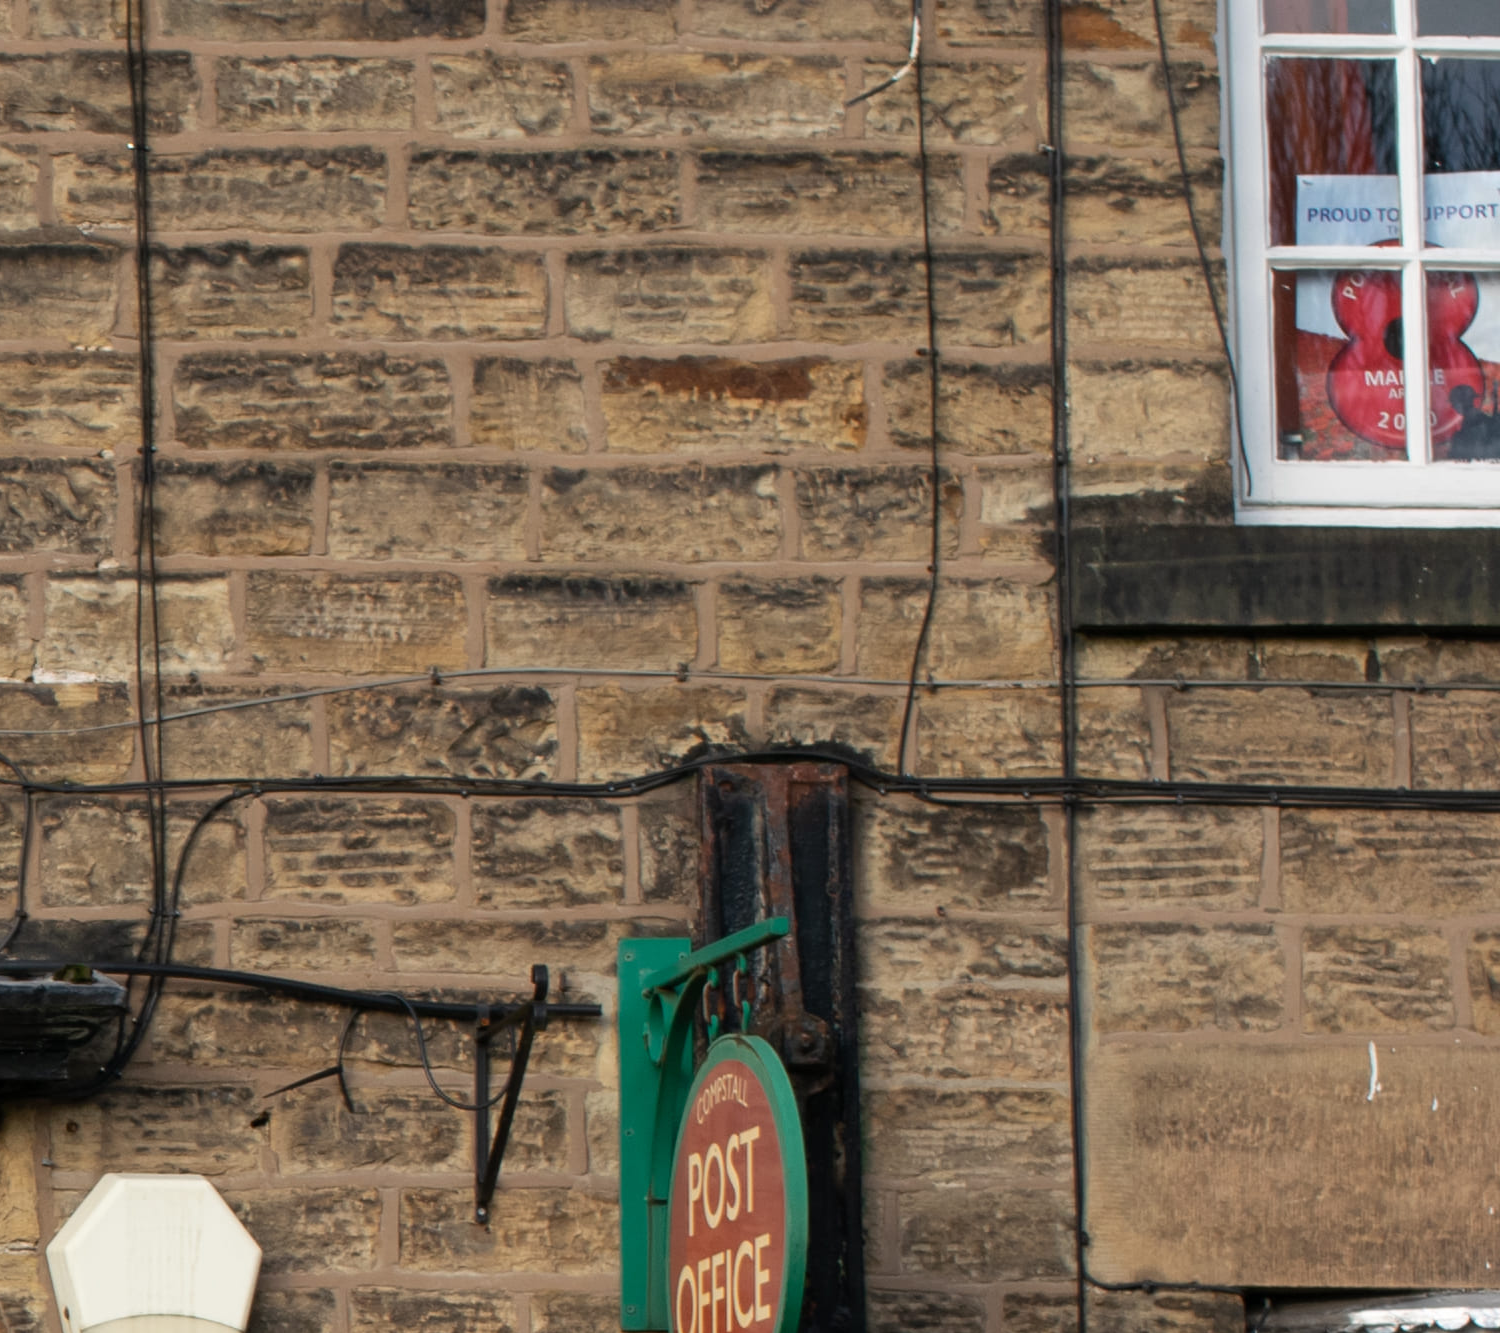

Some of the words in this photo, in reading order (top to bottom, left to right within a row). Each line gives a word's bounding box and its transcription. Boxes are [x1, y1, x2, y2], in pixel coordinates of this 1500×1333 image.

[1307, 208, 1371, 223] PROUD
[1376, 208, 1400, 222] TO
[1426, 203, 1499, 222] UPPORT
[696, 1072, 749, 1125] COMPSTALL
[688, 1125, 762, 1237] POST
